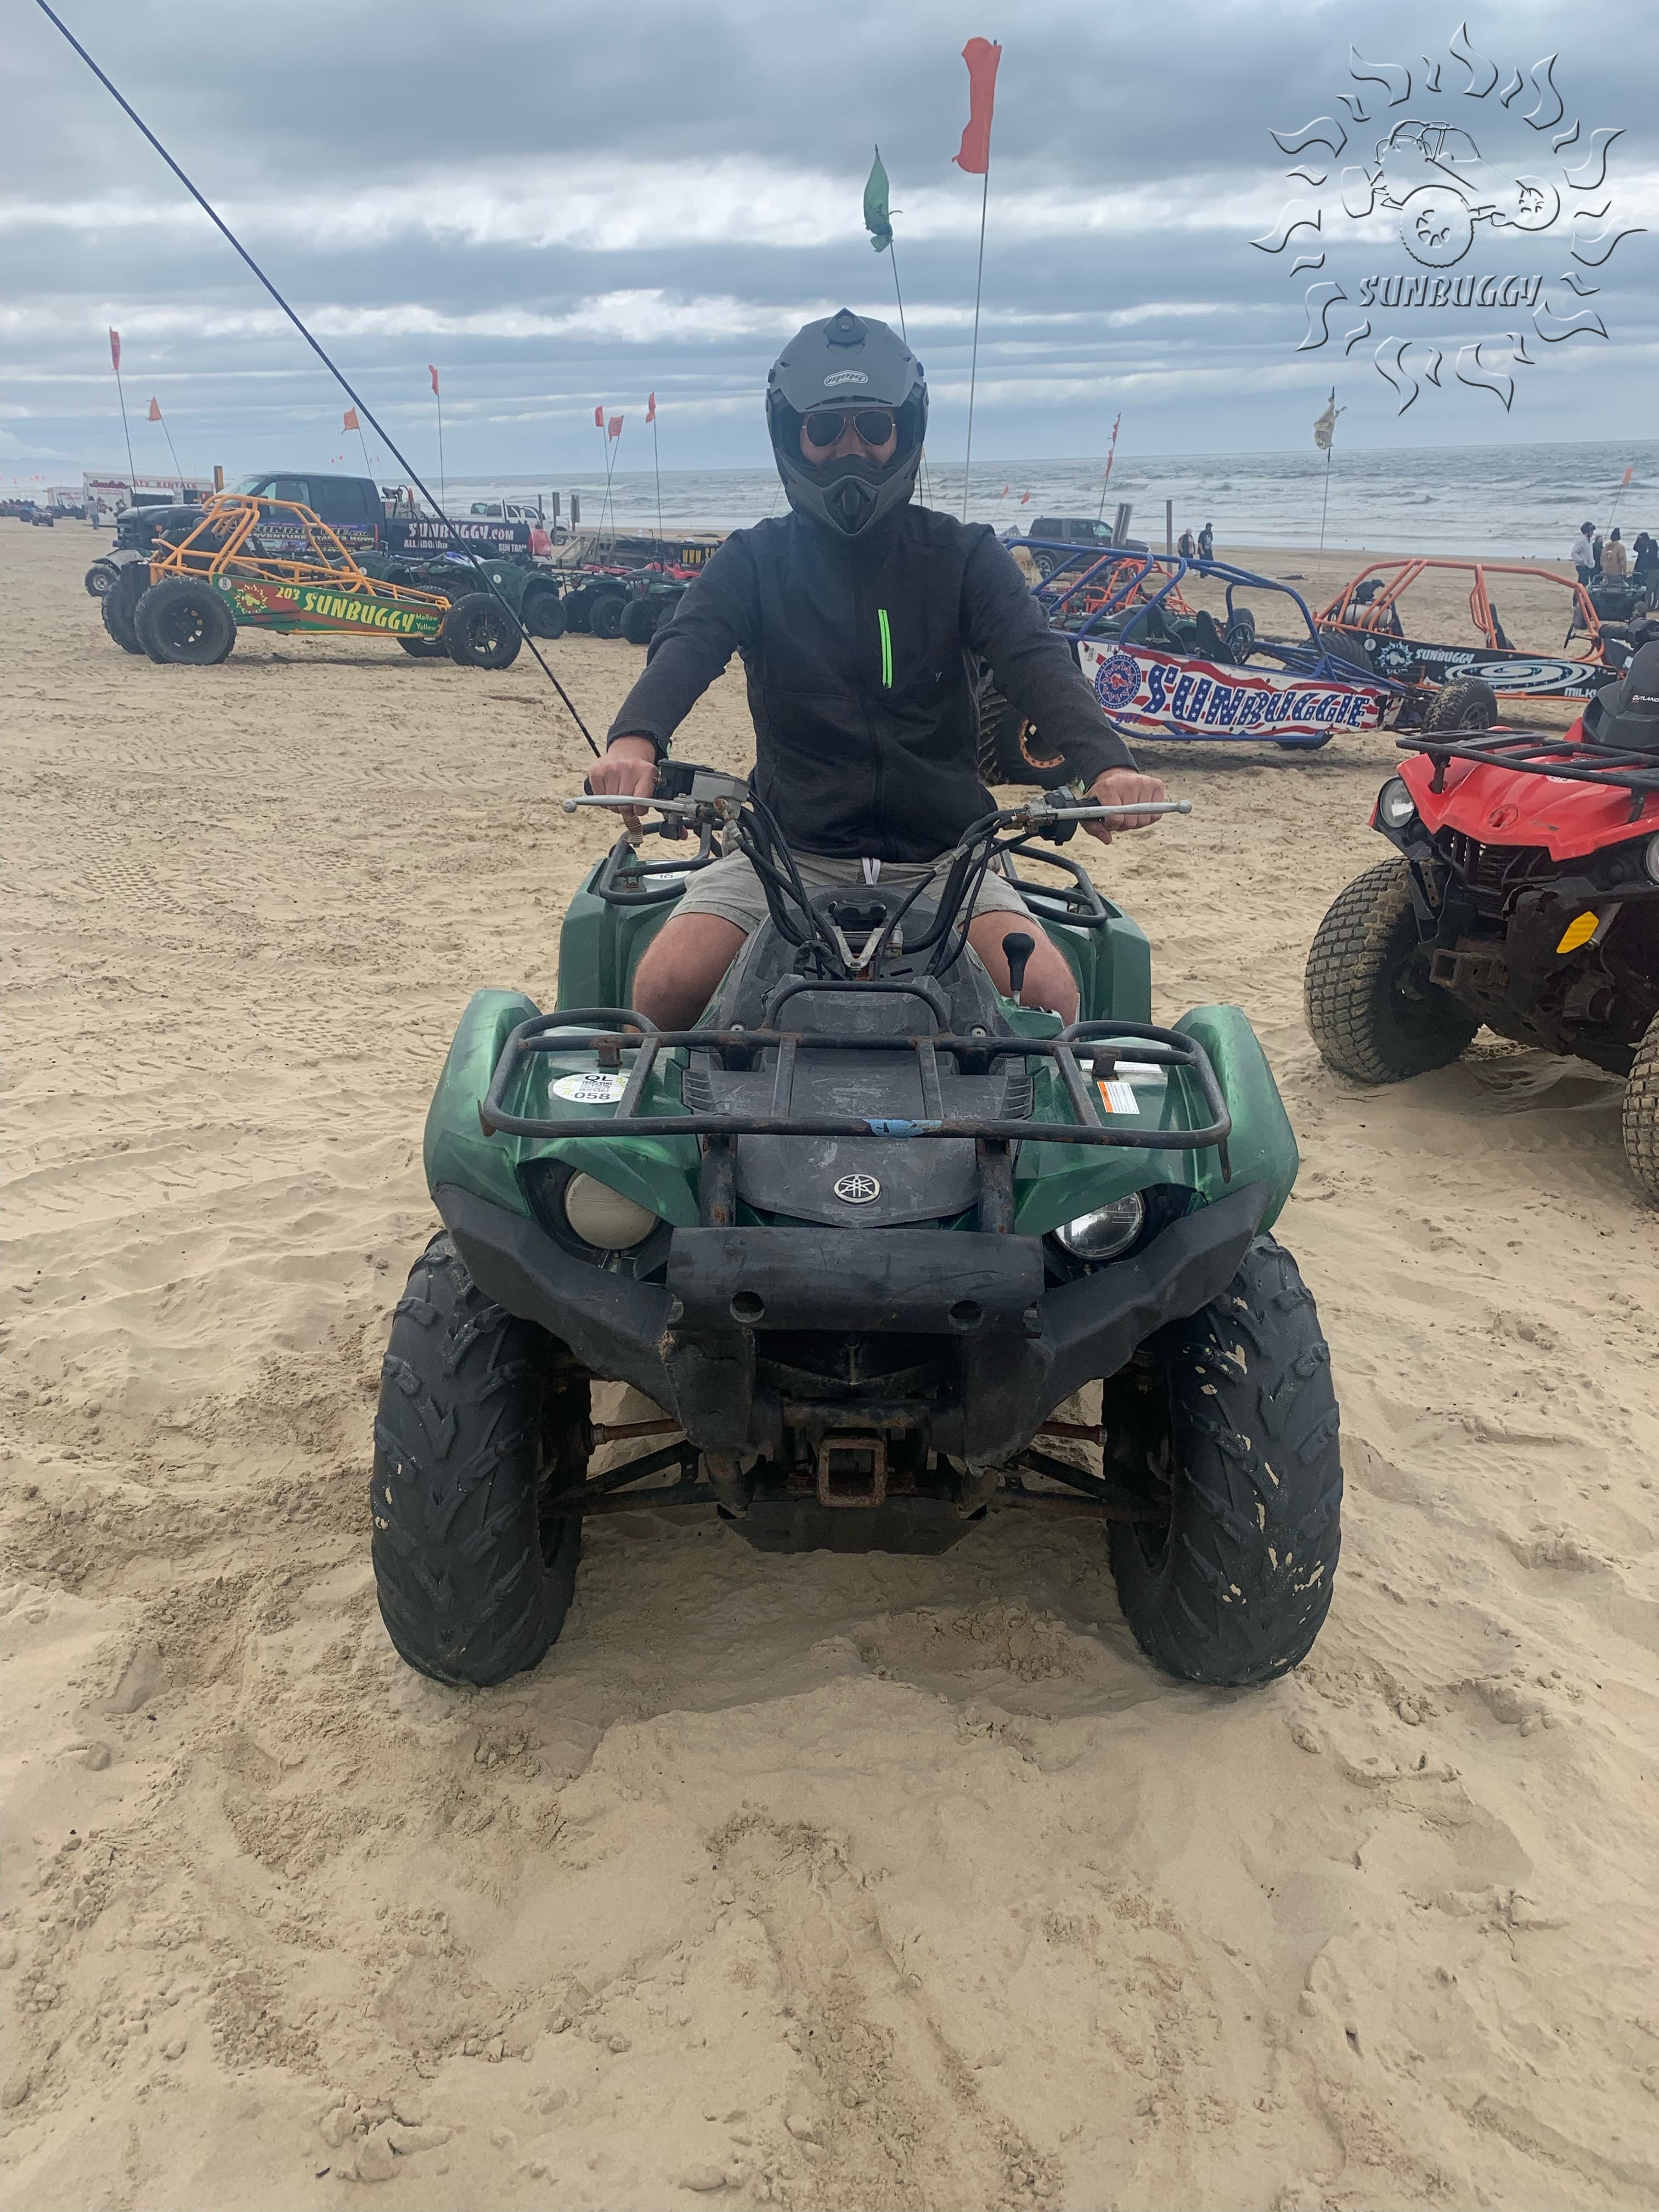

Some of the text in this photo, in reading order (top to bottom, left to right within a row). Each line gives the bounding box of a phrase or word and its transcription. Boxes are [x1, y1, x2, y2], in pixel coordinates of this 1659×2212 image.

[404, 539, 416, 548] ALL
[498, 543, 510, 552] SUN
[275, 585, 300, 600] 203
[303, 592, 415, 632] SUNBUGGY
[415, 613, 438, 621] Mellow
[1414, 648, 1475, 664] SUNBUGGY
[1141, 663, 1370, 727] SUNBUGGIE
[574, 1092, 611, 1100] 058
